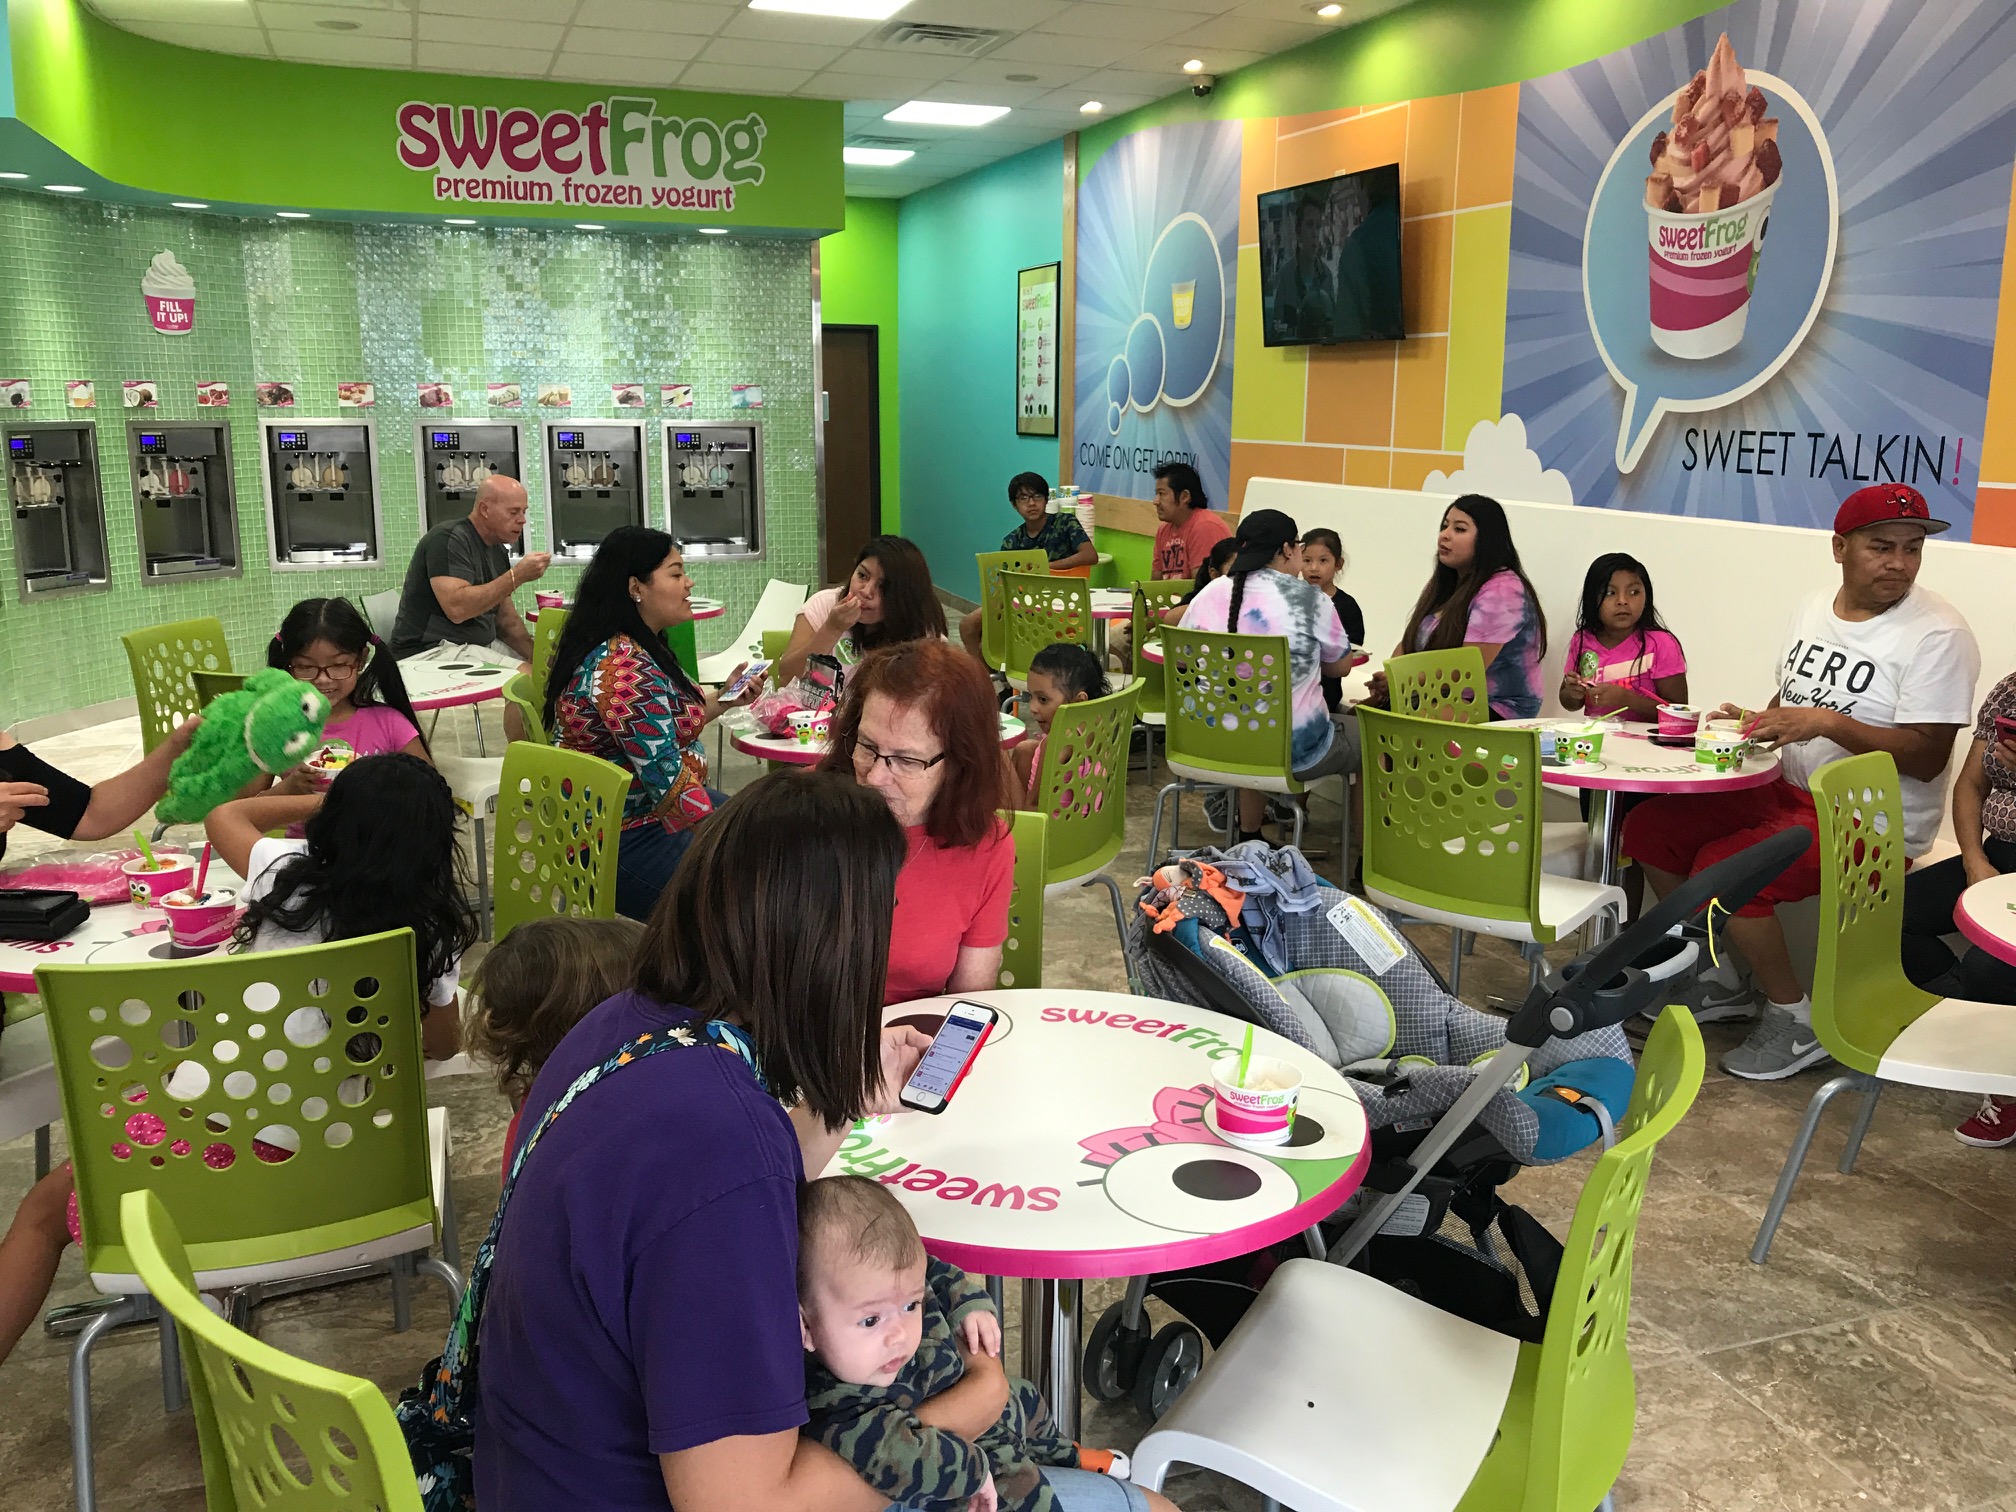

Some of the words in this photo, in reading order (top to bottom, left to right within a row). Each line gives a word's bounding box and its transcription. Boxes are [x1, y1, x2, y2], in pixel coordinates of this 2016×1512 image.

[400, 97, 764, 185] sweetFrog
[437, 175, 553, 203] premium
[562, 177, 643, 206] frozen
[652, 184, 734, 210] yogurt
[1659, 213, 1748, 250] sweetFrog
[1664, 249, 1689, 261] premium
[1690, 250, 1712, 260] frozen
[1713, 243, 1738, 258] yogurt
[156, 311, 166, 322] IT
[169, 312, 188, 323] UP!
[159, 300, 182, 312] FILL
[1080, 442, 1111, 468] COME
[1113, 446, 1130, 470] ON
[1133, 447, 1155, 473] GET
[1682, 428, 1795, 475] SWEET
[1807, 433, 1963, 485] TALKIN!
[1784, 639, 1876, 694] AERO
[1781, 675, 1808, 705] New
[1040, 1007, 1243, 1060] sweetFro
[1230, 1091, 1285, 1105] sweetFrog
[837, 1133, 1061, 1212] sweetFro
